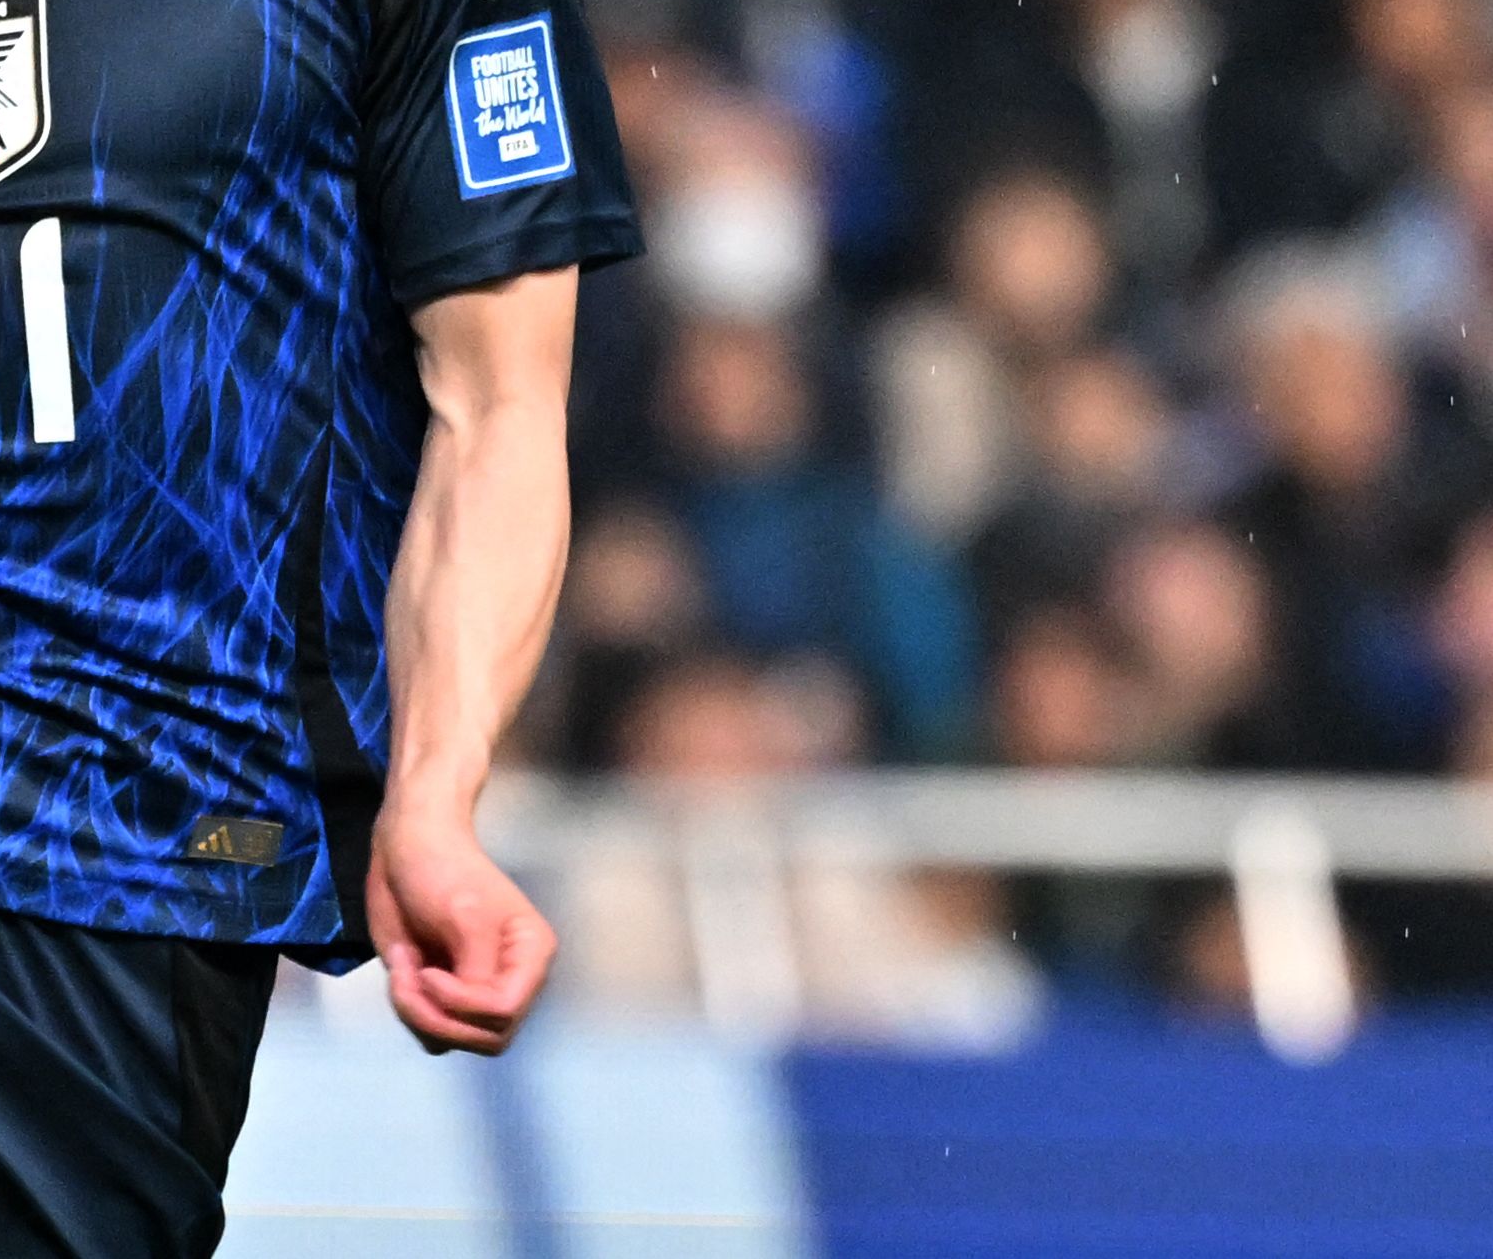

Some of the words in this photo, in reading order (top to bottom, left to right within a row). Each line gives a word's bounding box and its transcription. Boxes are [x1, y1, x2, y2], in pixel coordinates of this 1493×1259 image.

[472, 46, 536, 78] FOOTBALL
[475, 68, 538, 108] UNITES
[474, 109, 504, 136] the
[505, 98, 546, 130] World
[507, 140, 528, 152] FIFA
